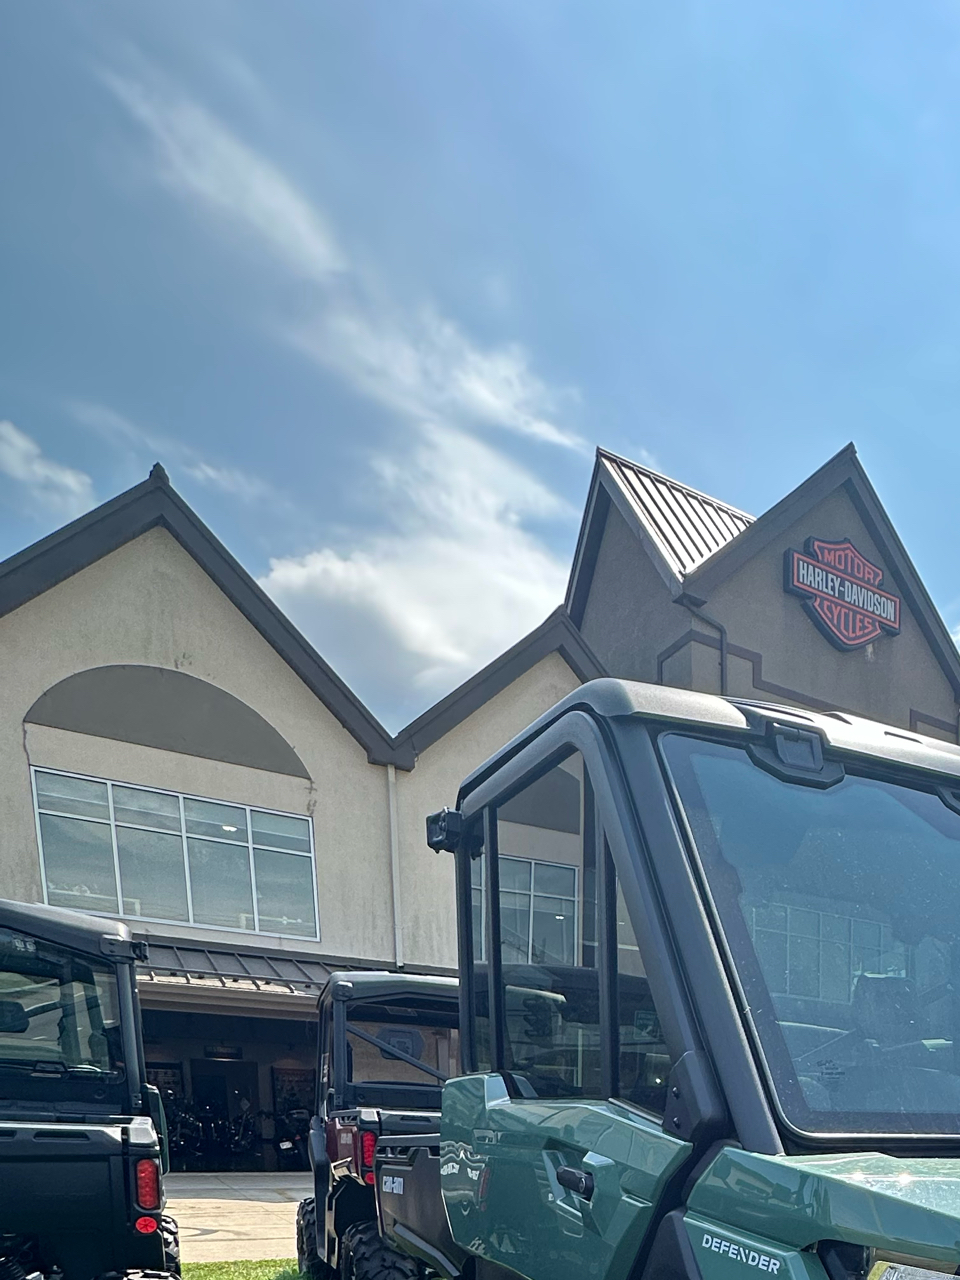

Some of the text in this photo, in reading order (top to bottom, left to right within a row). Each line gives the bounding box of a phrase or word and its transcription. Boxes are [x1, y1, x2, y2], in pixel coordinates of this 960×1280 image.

[824, 549, 874, 584] MOTOR
[799, 560, 895, 622] HARLEY-DAVIDSON
[823, 600, 873, 638] CYCLES
[702, 1233, 781, 1275] DEFENDER
